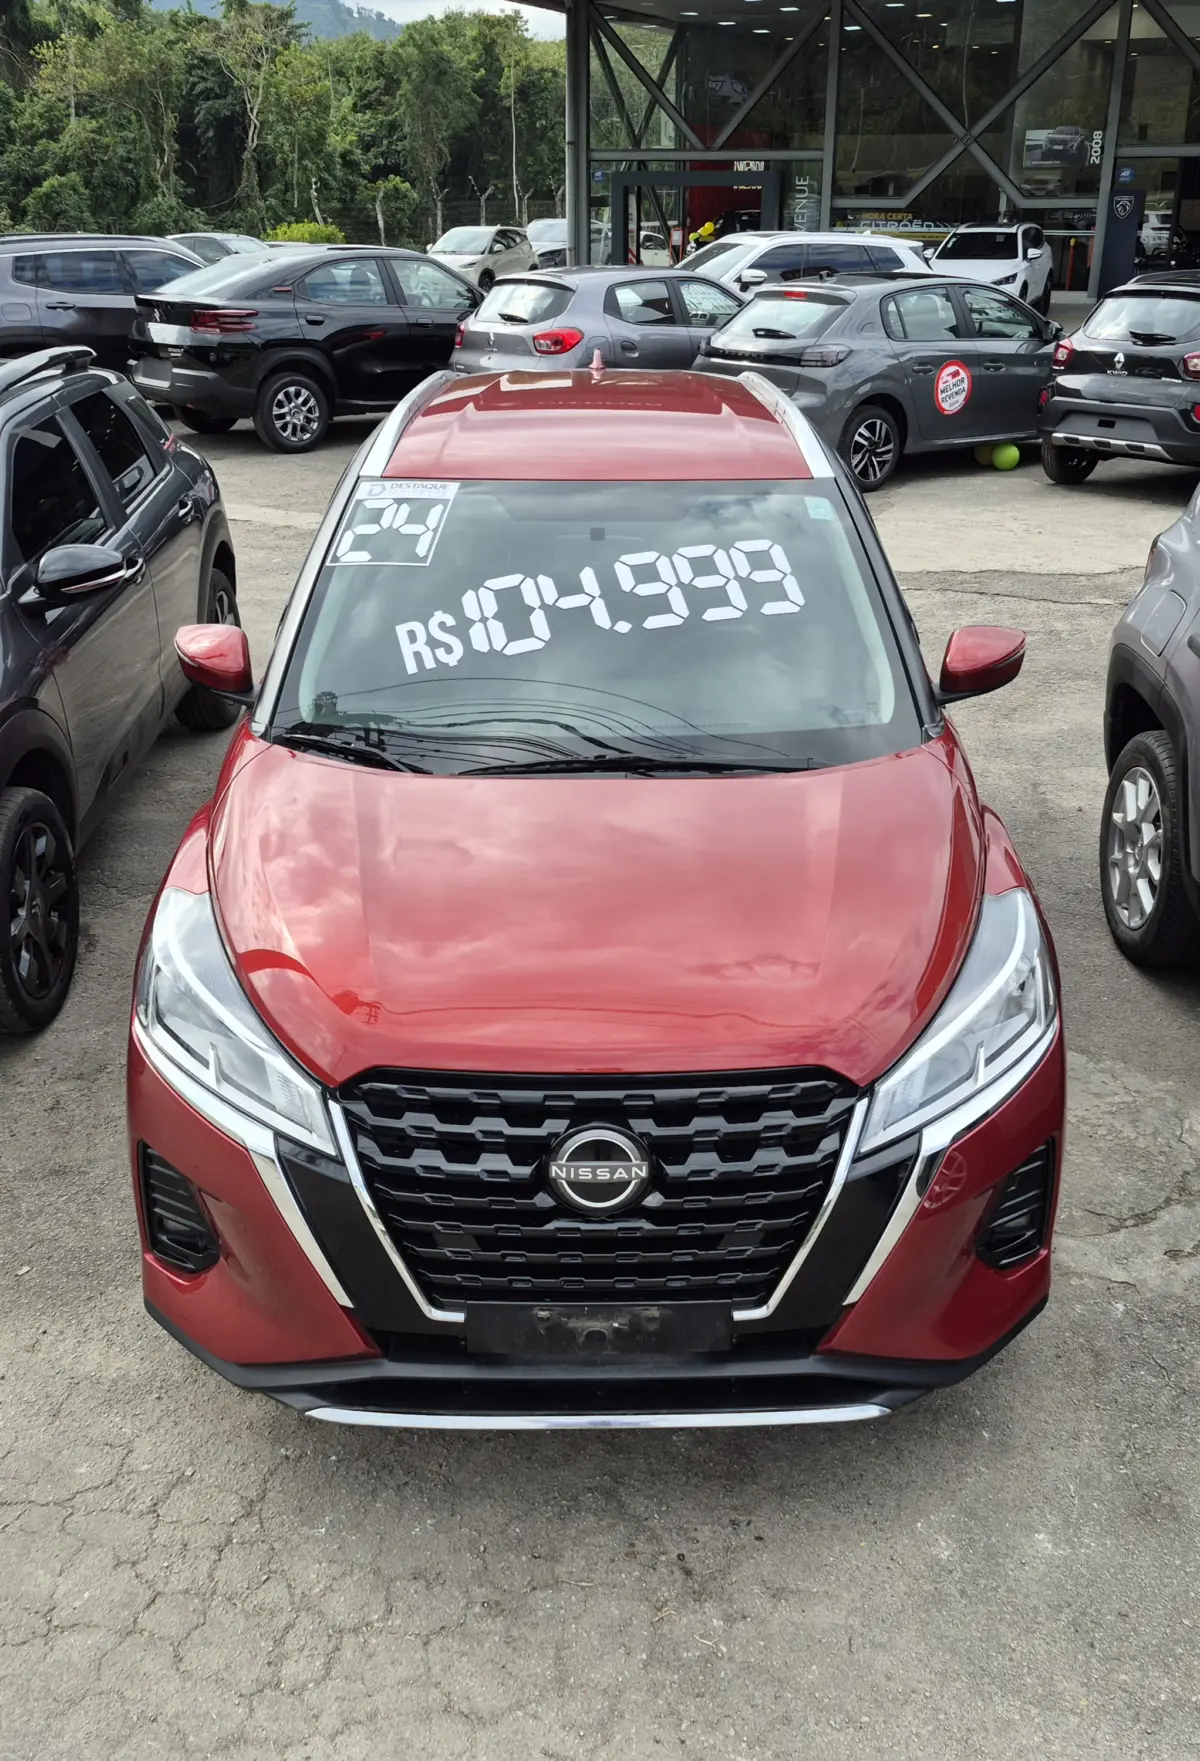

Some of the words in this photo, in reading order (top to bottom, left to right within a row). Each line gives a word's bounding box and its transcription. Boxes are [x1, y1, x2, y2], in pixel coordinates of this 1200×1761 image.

[1090, 130, 1103, 164] 2008
[886, 212, 913, 220] CERTA
[940, 377, 965, 395] MELHOR
[941, 386, 966, 403] REVENDA
[336, 499, 444, 563] 24
[551, 1165, 646, 1180] NISSAN
